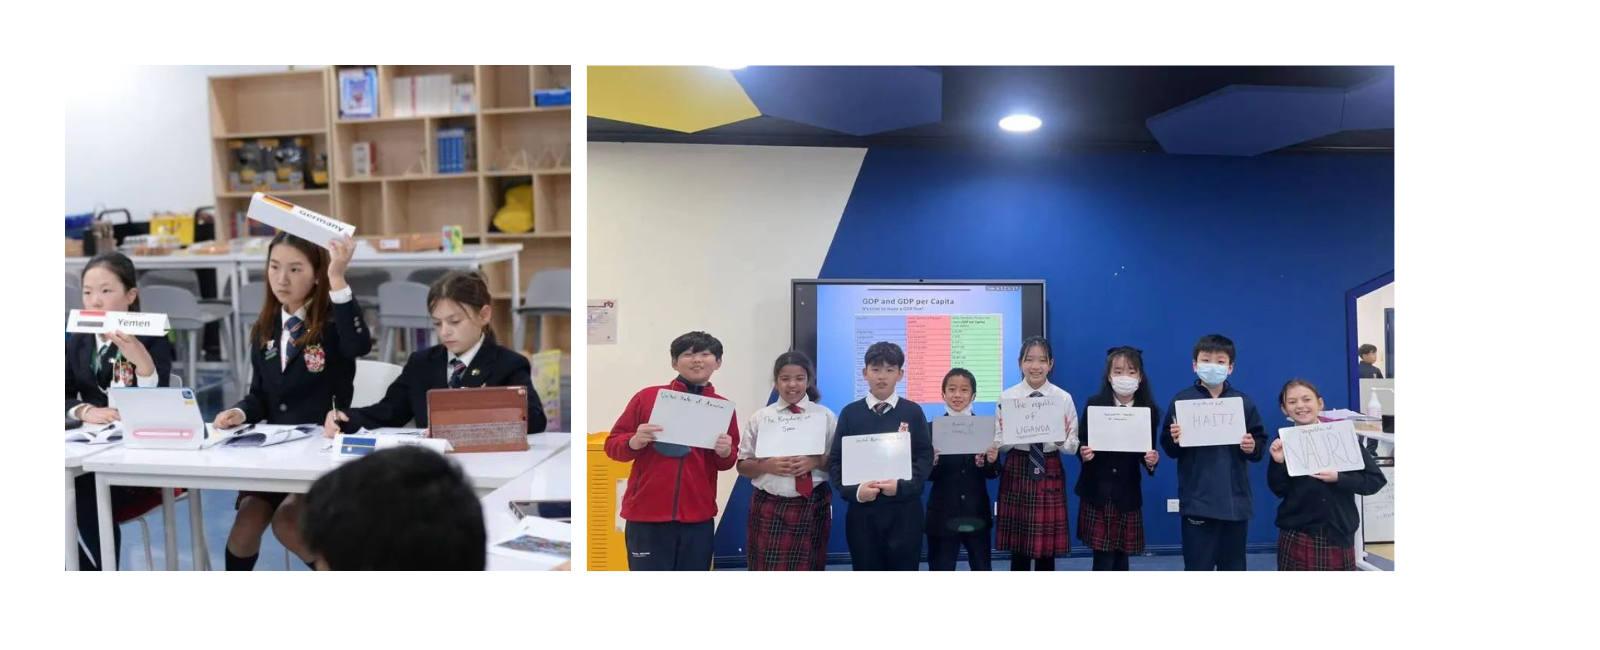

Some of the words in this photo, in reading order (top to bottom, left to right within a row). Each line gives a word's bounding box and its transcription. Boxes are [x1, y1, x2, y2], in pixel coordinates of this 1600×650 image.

[299, 210, 344, 232] Germany
[930, 298, 955, 306] Capita
[118, 318, 151, 328] Yemen
[1014, 399, 1026, 409] The
[1031, 399, 1055, 410] republic
[764, 415, 775, 423] The
[1025, 411, 1037, 421] of
[1192, 413, 1234, 429] HAITI
[1016, 425, 1051, 435] UGANDA
[1284, 429, 1360, 471] NAURU
